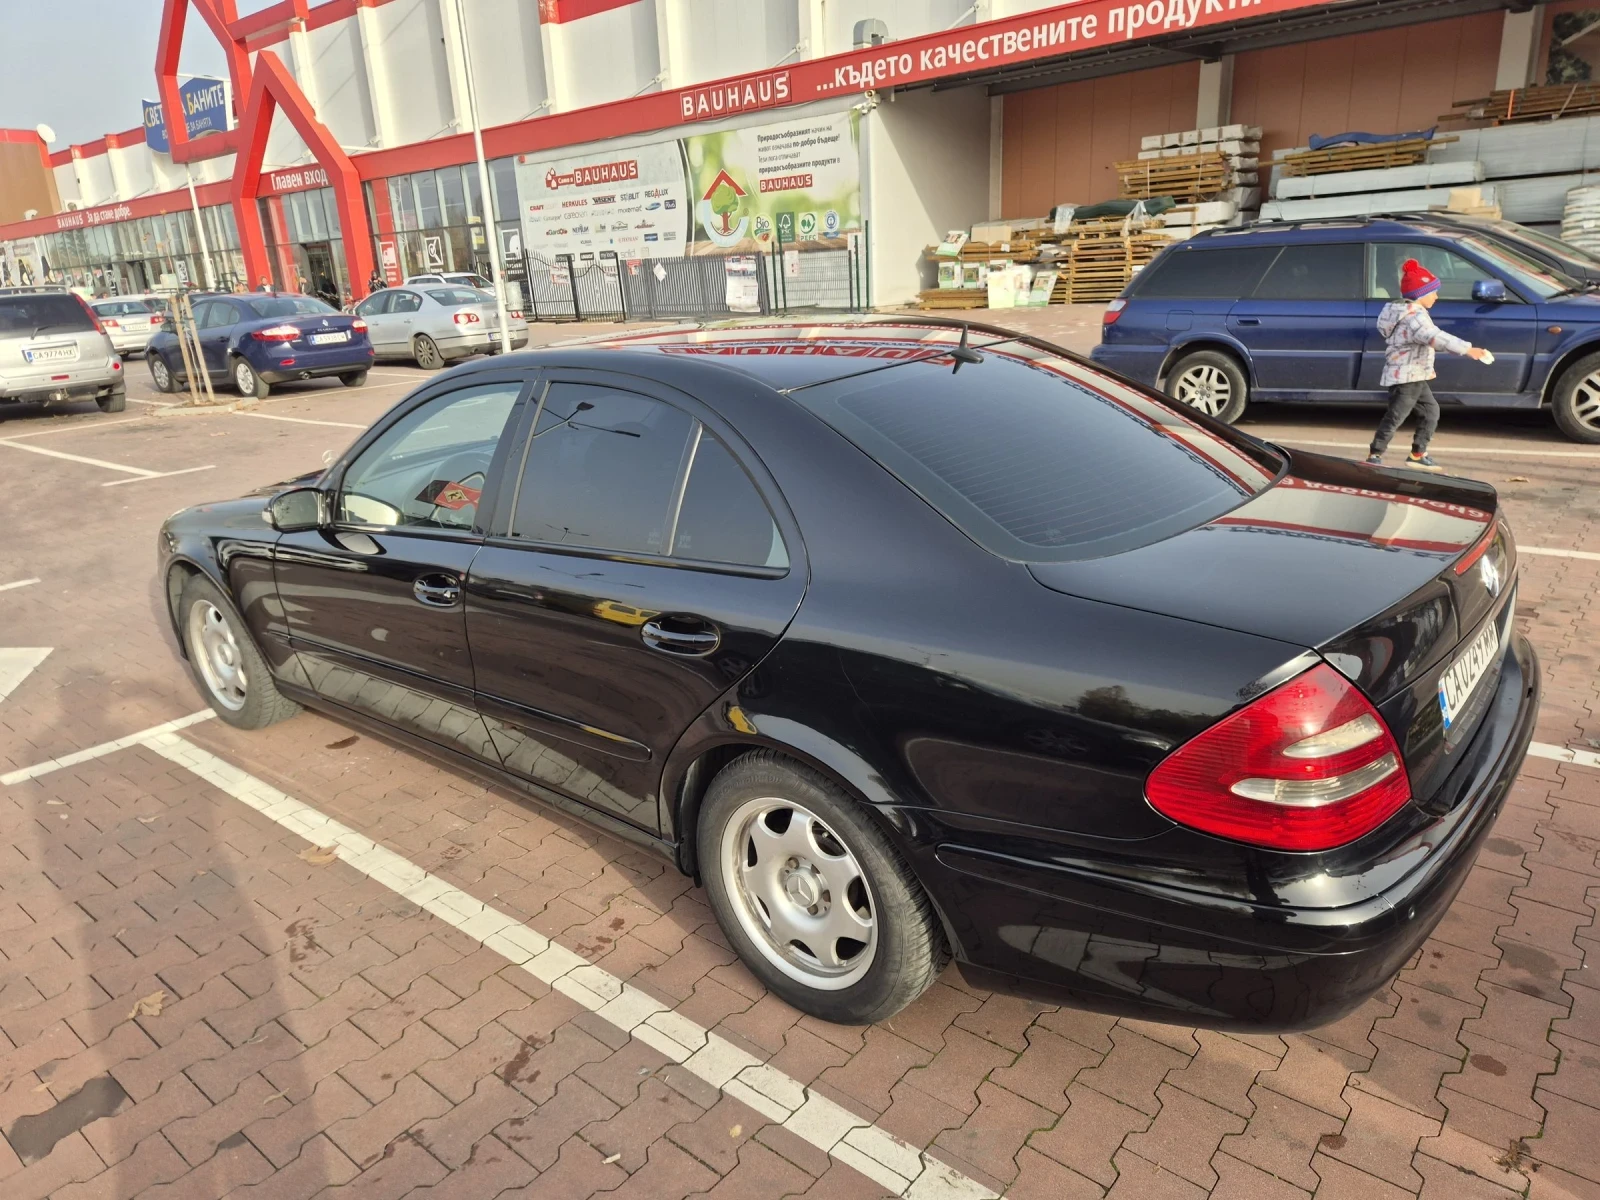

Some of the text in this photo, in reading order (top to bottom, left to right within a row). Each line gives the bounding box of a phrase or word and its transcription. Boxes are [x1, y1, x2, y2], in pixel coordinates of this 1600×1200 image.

[816, 53, 913, 91] ...където
[919, 14, 1098, 71] качествените
[186, 83, 225, 116] БАНИТЕ
[682, 76, 789, 116] BAUHAUS
[270, 168, 329, 190] Главен вход
[574, 162, 638, 184] BAUHAUS
[760, 174, 813, 191] BAUHAUS
[644, 188, 669, 199] REGALUX
[561, 199, 588, 208] HERKULES
[57, 214, 84, 229] BAUHAUS
[756, 216, 770, 229] Bio
